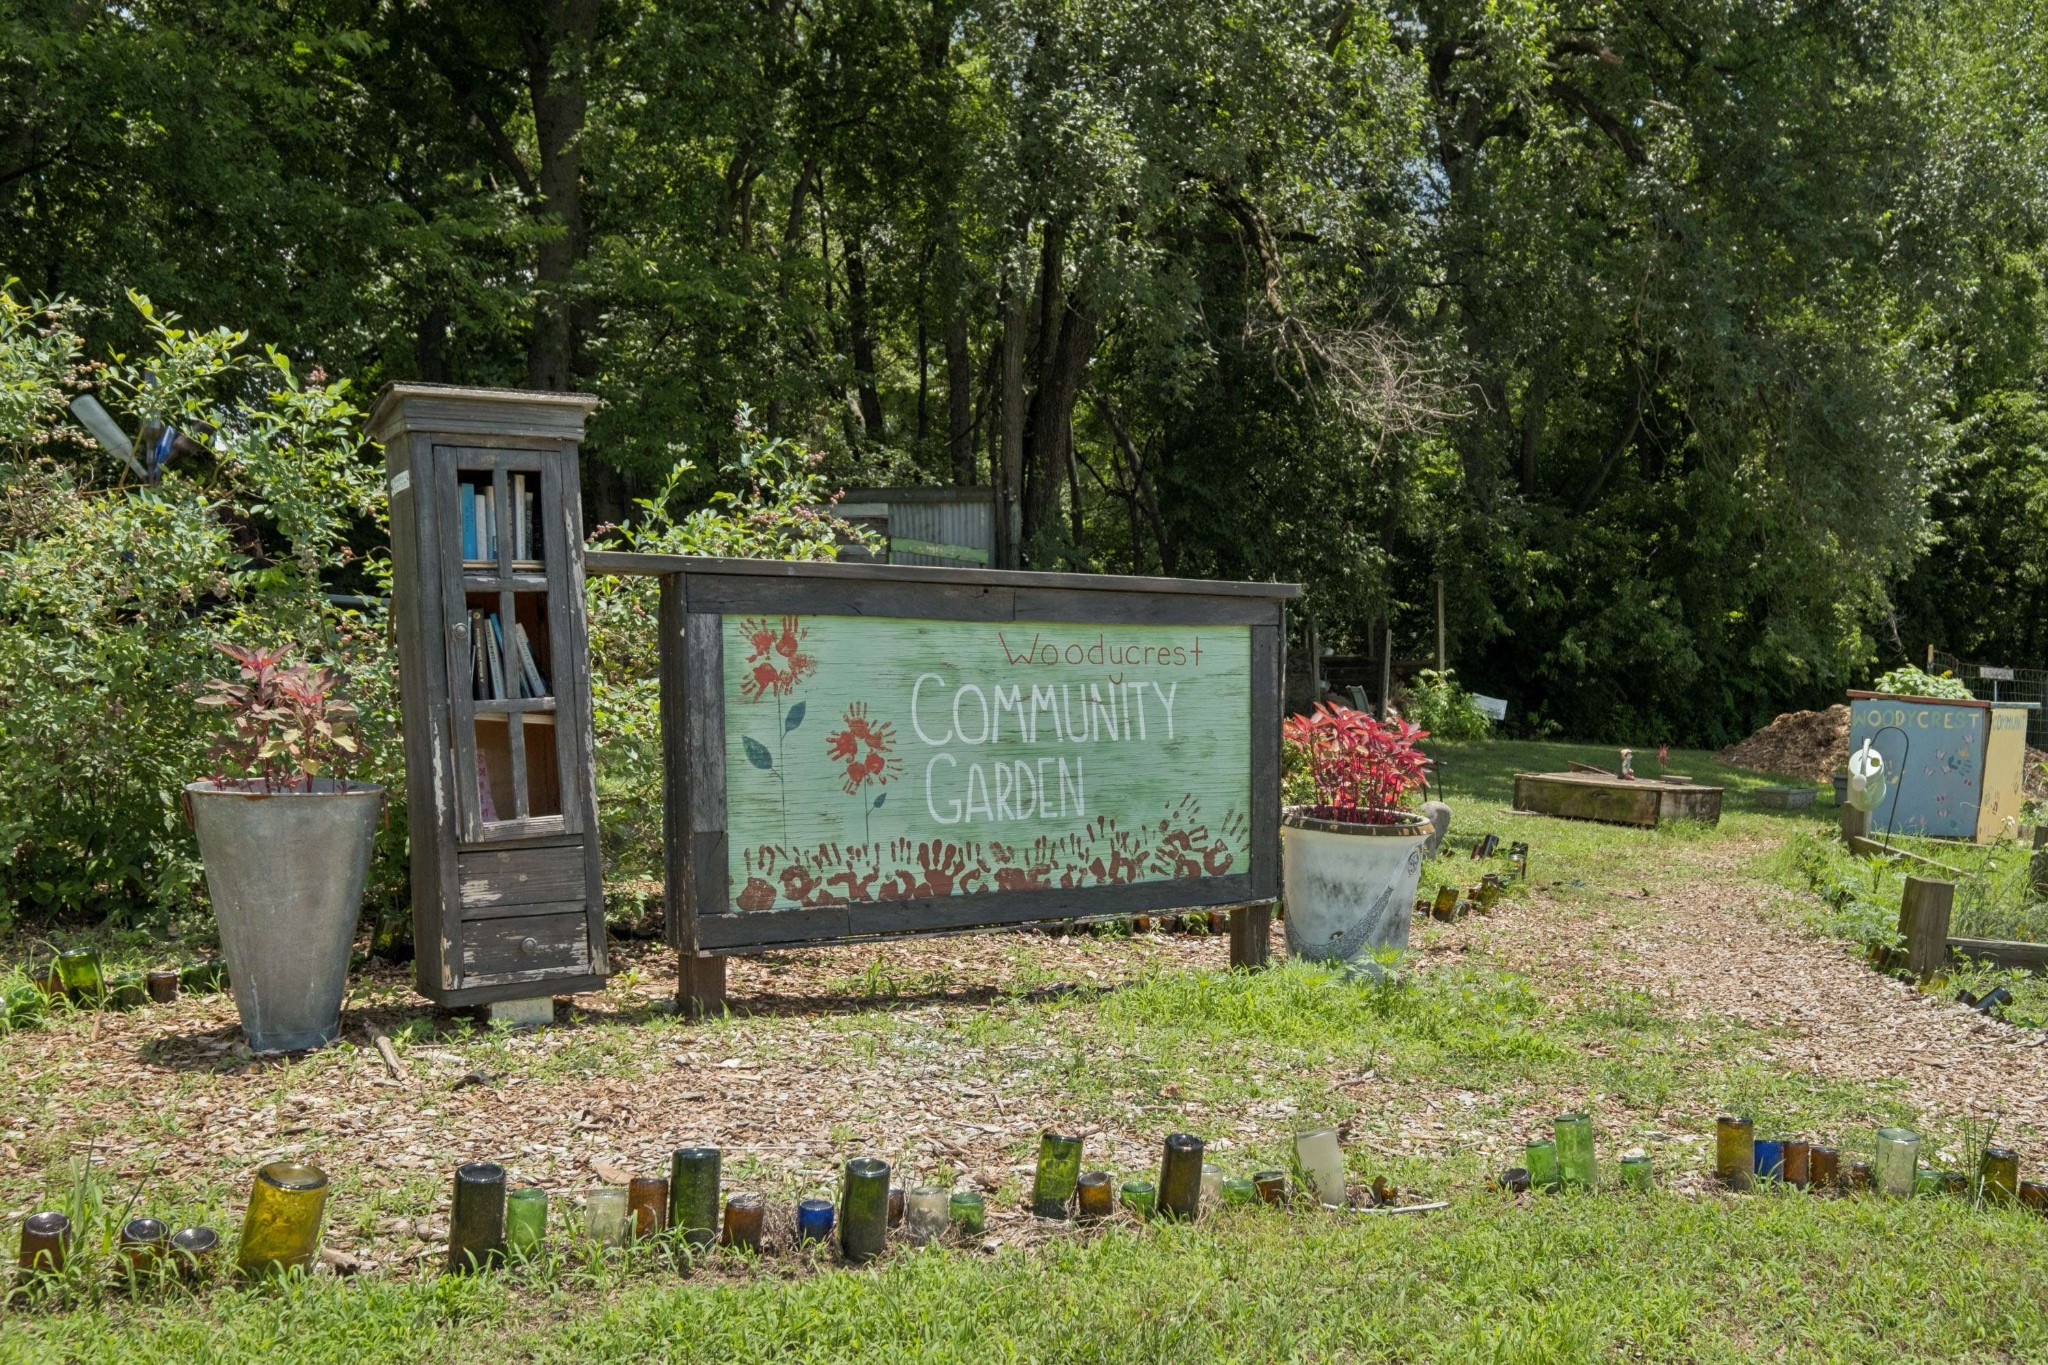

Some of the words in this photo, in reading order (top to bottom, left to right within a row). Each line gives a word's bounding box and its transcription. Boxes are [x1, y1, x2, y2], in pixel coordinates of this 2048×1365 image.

[911, 672, 1178, 746] COMMUNITY
[1853, 709, 1980, 729] WOODYCREST
[925, 752, 1086, 825] GARDEN
